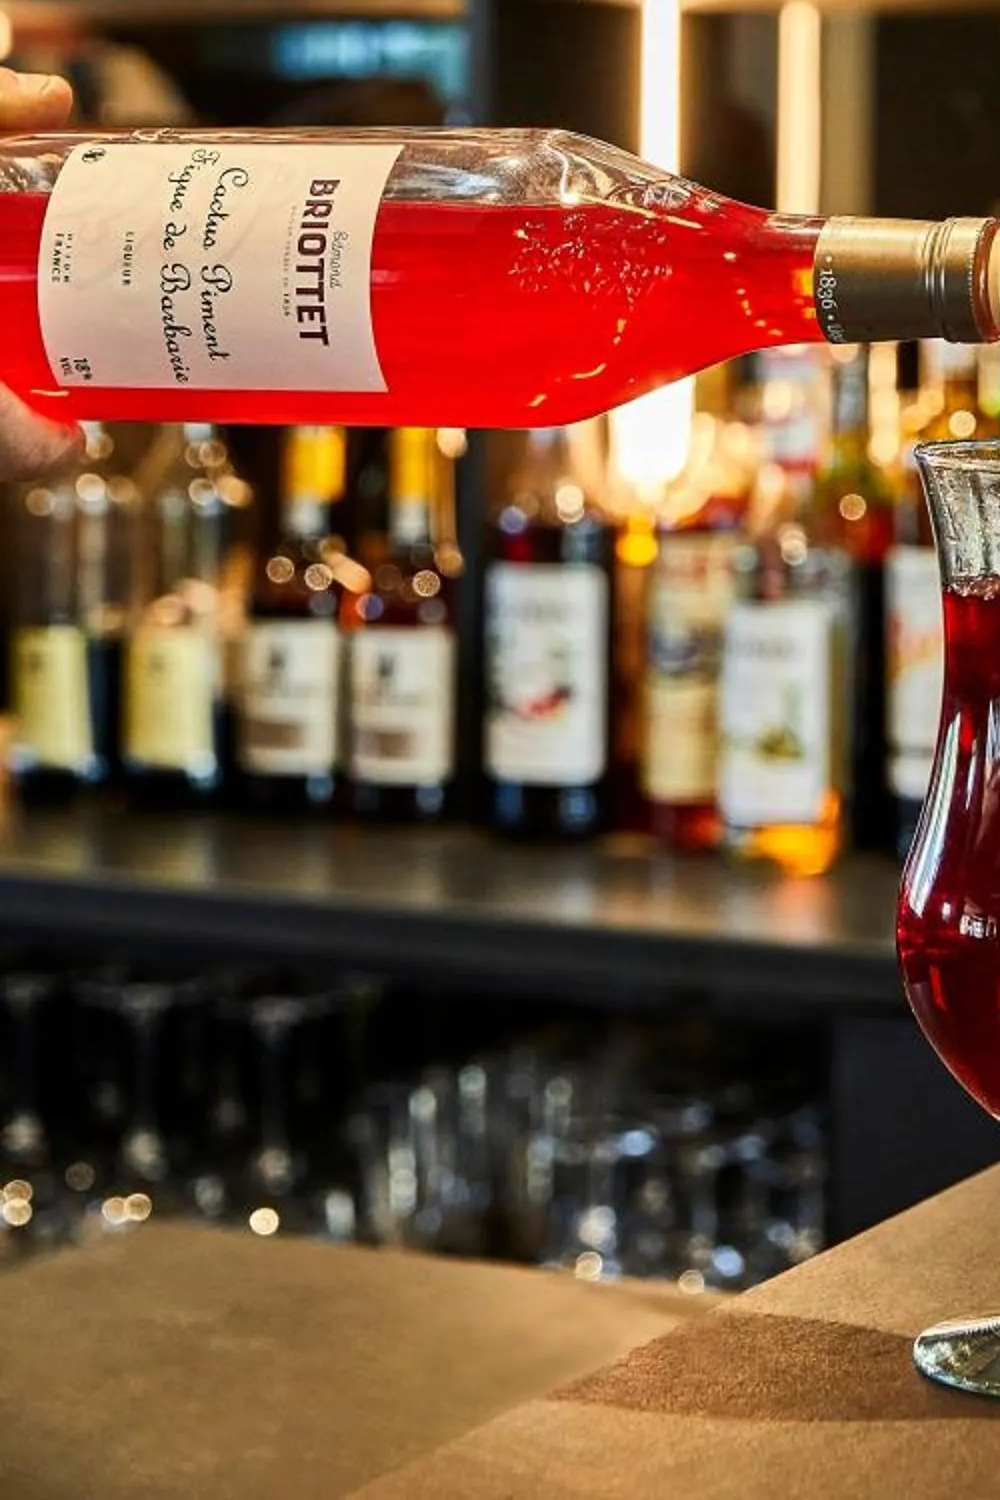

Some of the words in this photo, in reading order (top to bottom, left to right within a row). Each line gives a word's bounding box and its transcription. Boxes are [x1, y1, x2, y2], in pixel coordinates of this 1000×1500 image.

[168, 149, 220, 212] Figue
[203, 167, 249, 250] Cactus
[51, 233, 63, 283] FRANCE
[122, 231, 135, 286] LIQUEUR
[163, 222, 187, 251] de
[296, 179, 341, 346] BRIOTTET
[200, 264, 233, 361] Piment
[817, 268, 838, 309] 1836
[160, 263, 193, 384] Barbarie
